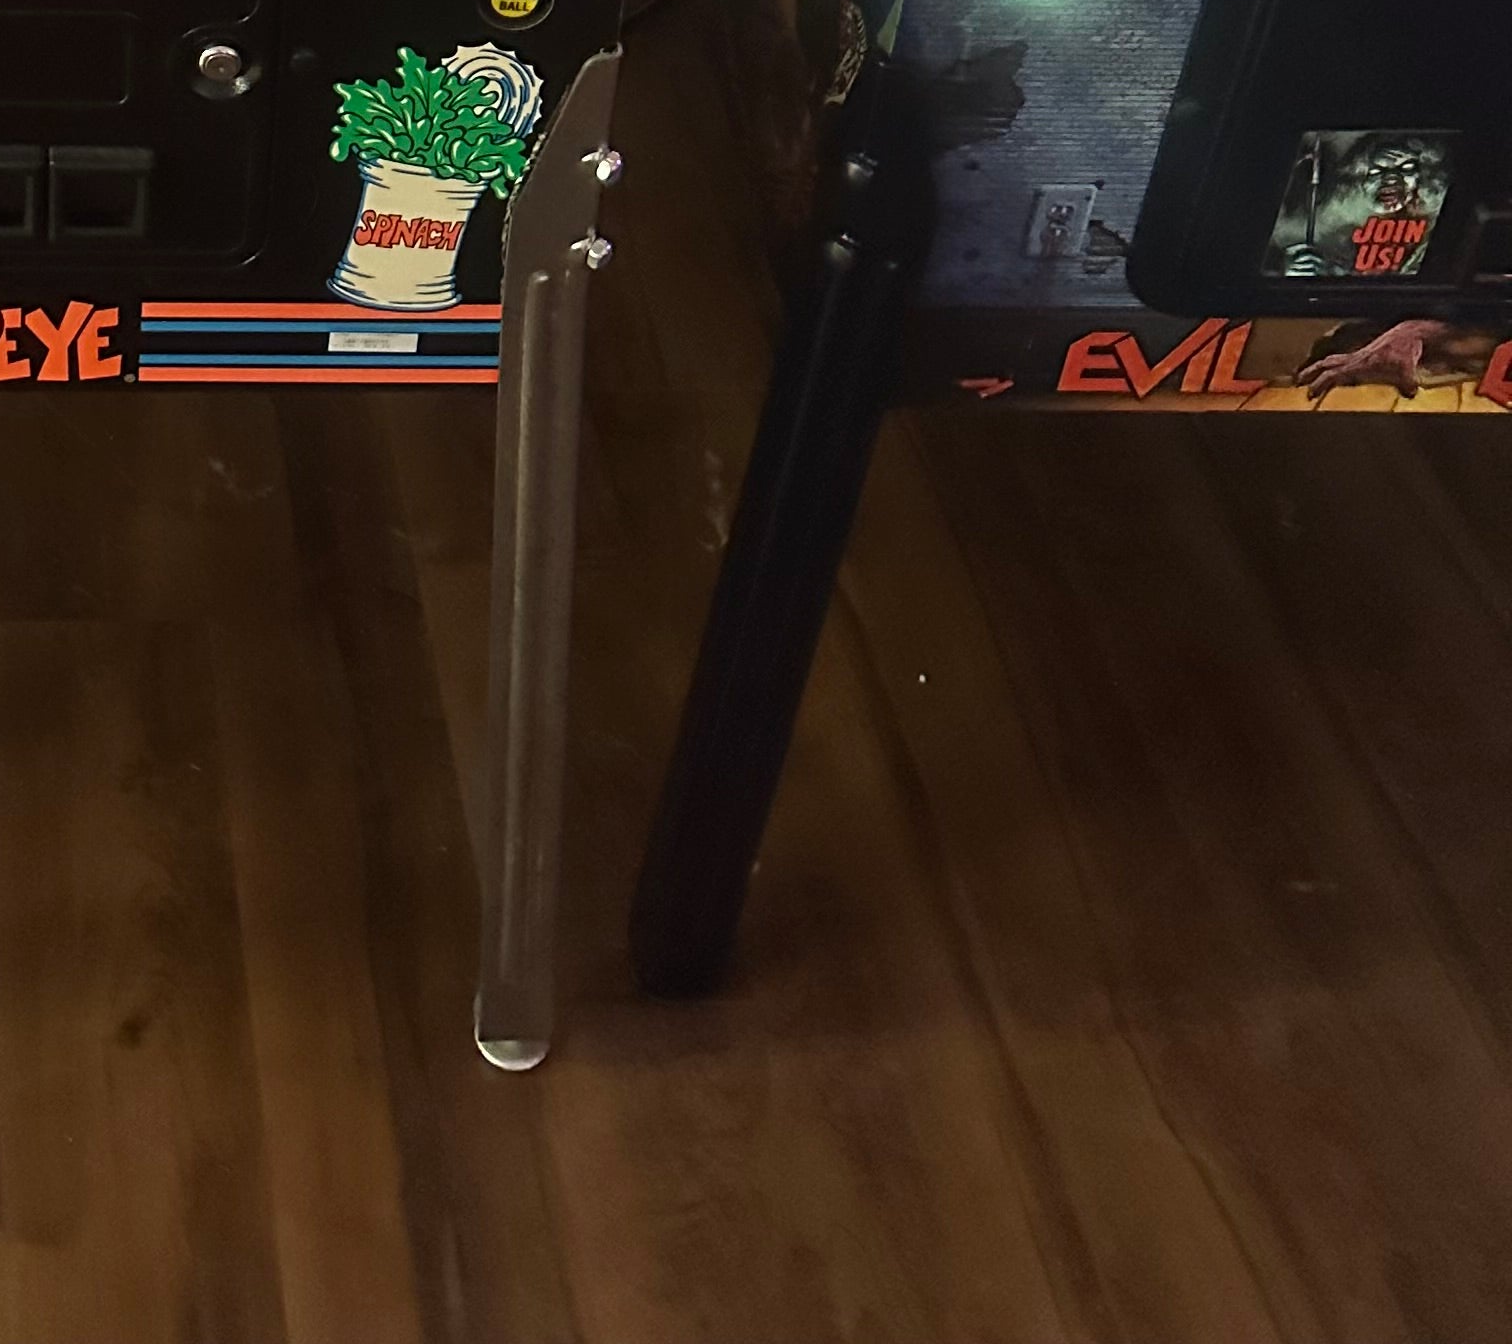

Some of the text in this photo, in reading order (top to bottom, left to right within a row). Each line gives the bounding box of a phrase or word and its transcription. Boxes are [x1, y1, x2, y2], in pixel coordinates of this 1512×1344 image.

[499, 0, 530, 12] BALL
[353, 208, 463, 252] SPINACH
[1352, 216, 1428, 244] JOIN
[1354, 243, 1406, 272] US!
[1055, 316, 1274, 398] EVIL
